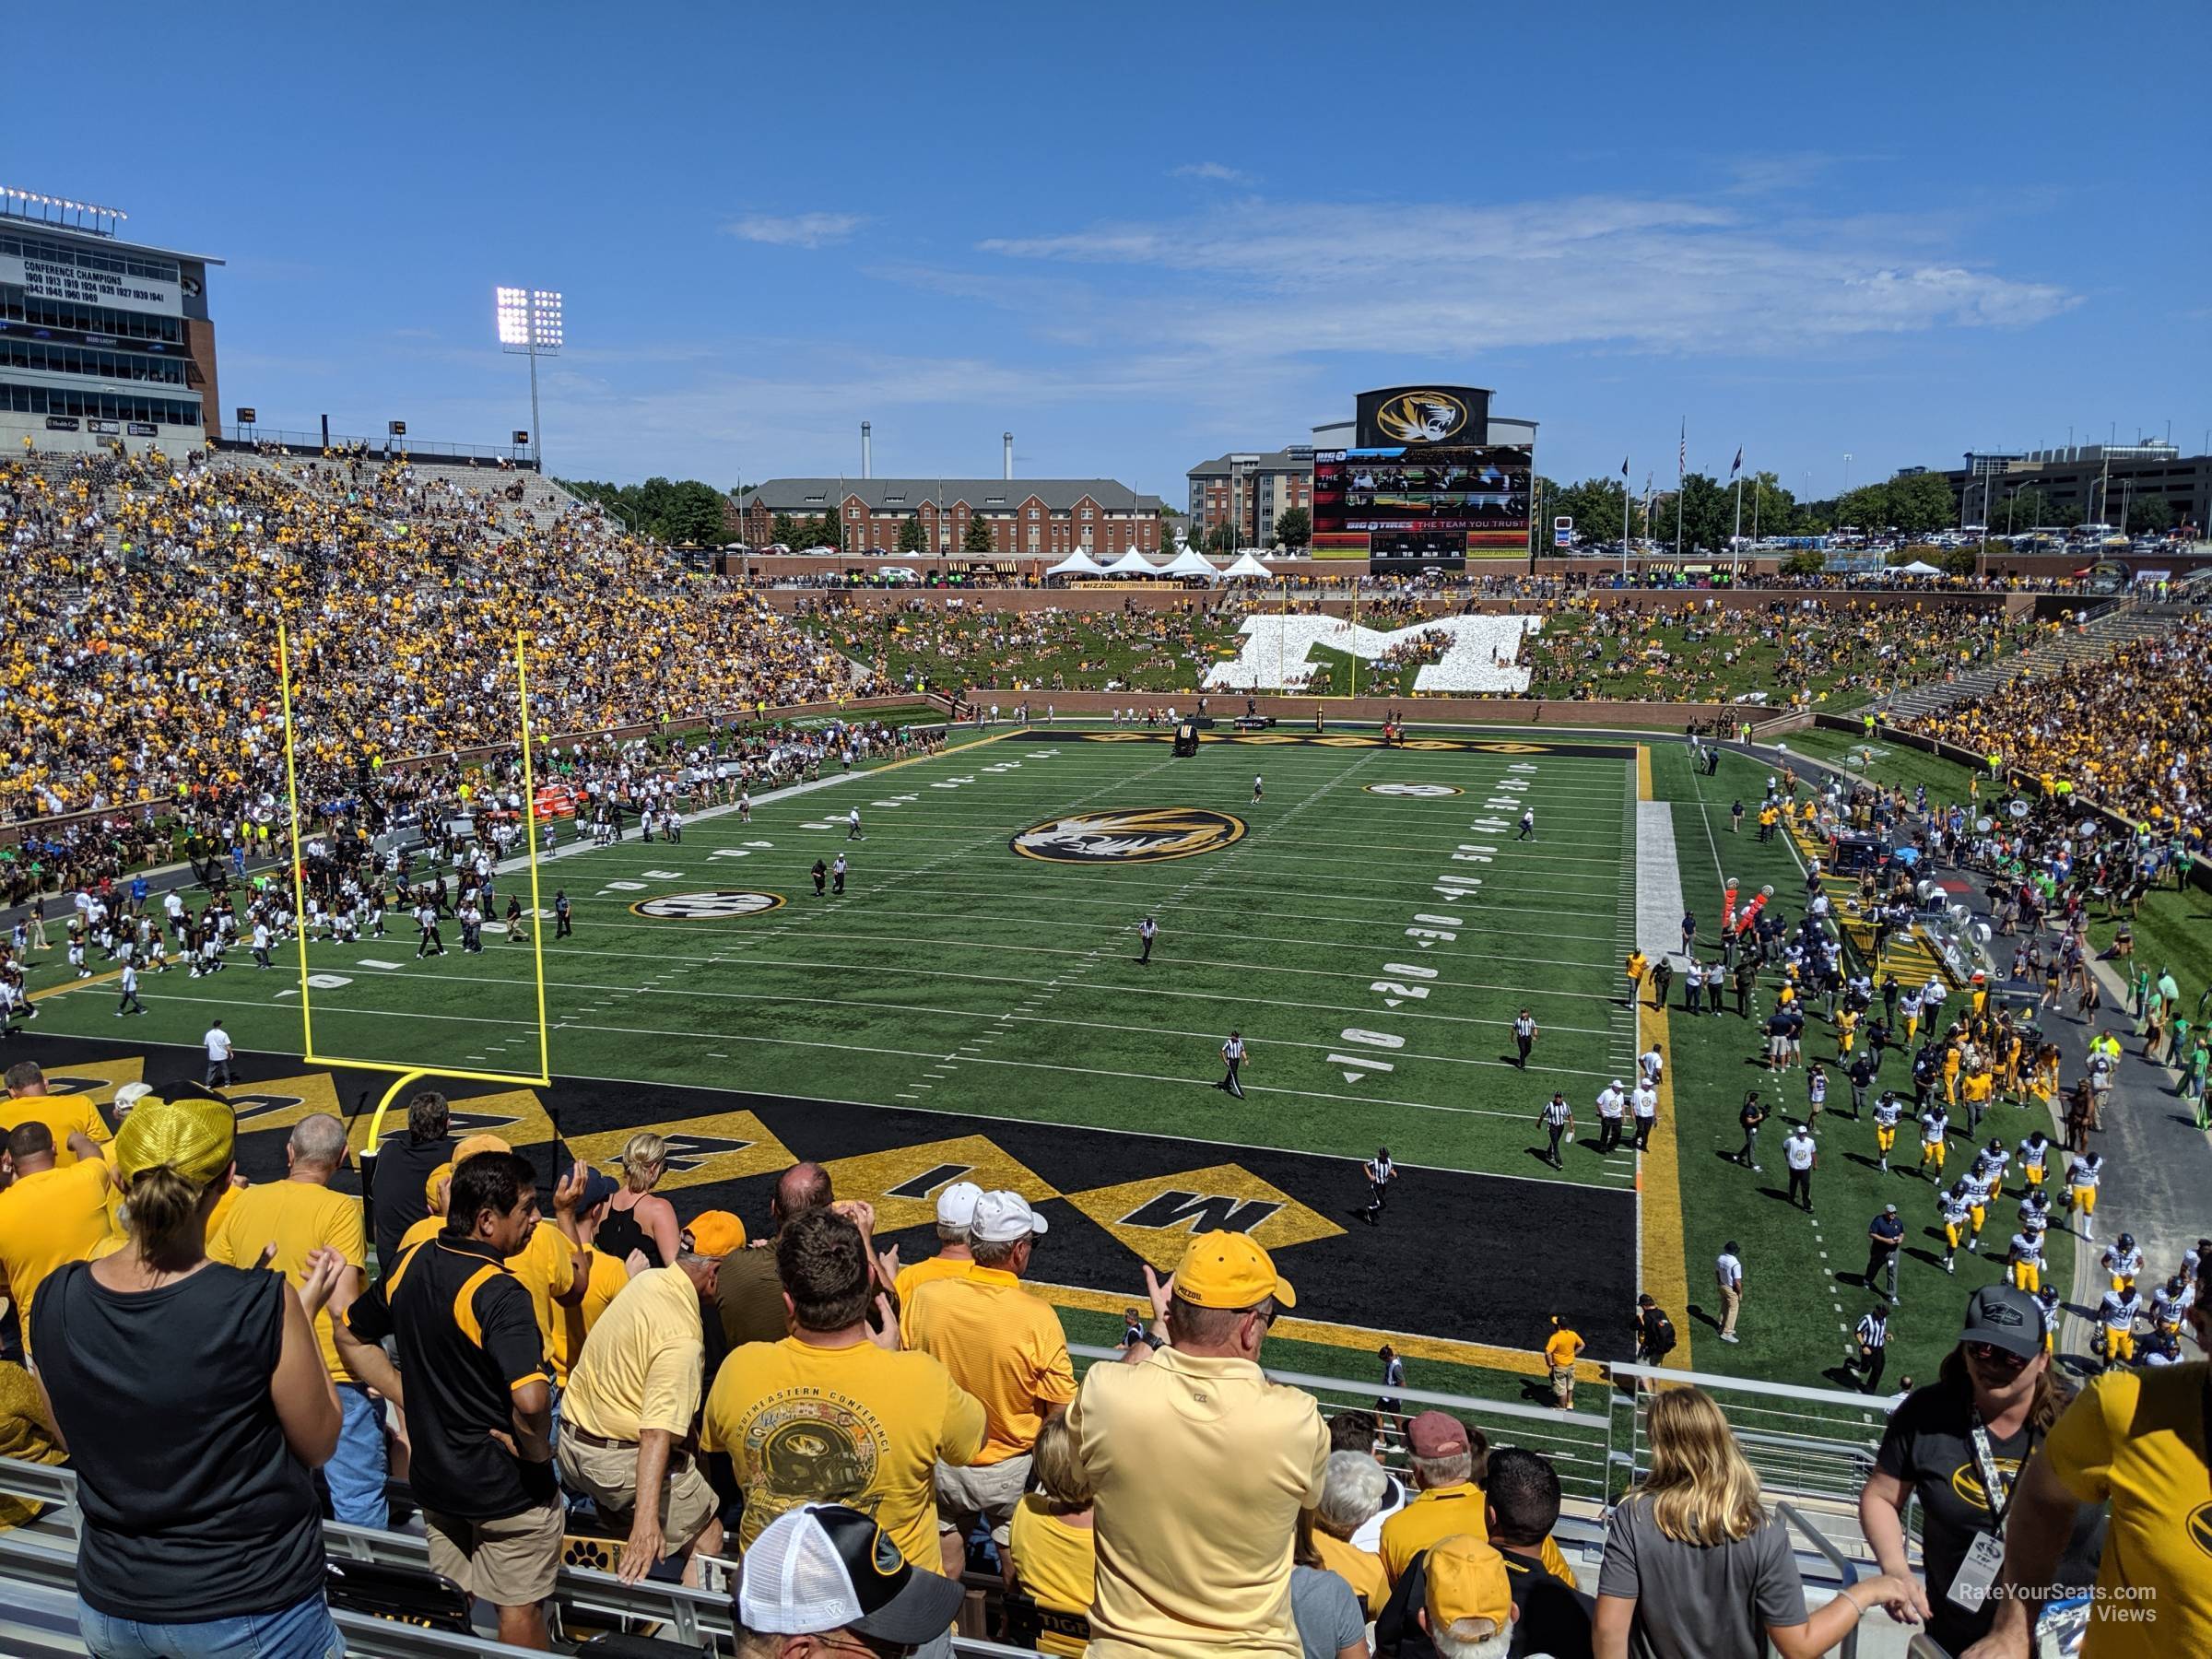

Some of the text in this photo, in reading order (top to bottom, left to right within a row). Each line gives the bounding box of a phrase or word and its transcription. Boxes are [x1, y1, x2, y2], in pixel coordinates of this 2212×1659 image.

[24, 261, 123, 286] CONFERENCE CHAMPIONS
[25, 272, 164, 302] 1909 1913 1919 1924 1925 1927 1939 1941
[65, 289, 80, 300] 1960
[82, 292, 99, 303] 1969
[100, 337, 117, 346] LIGHT
[1201, 615, 1542, 692] M
[1451, 844, 1499, 863] 50
[1431, 875, 1483, 896] 40
[1405, 913, 1464, 942] 30
[1369, 962, 1439, 999] 20
[1326, 1028, 1406, 1072] 10
[1971, 1185, 1988, 1195] 95
[736, 1387, 892, 1454] SOUTHEASTERN CONFERENCE
